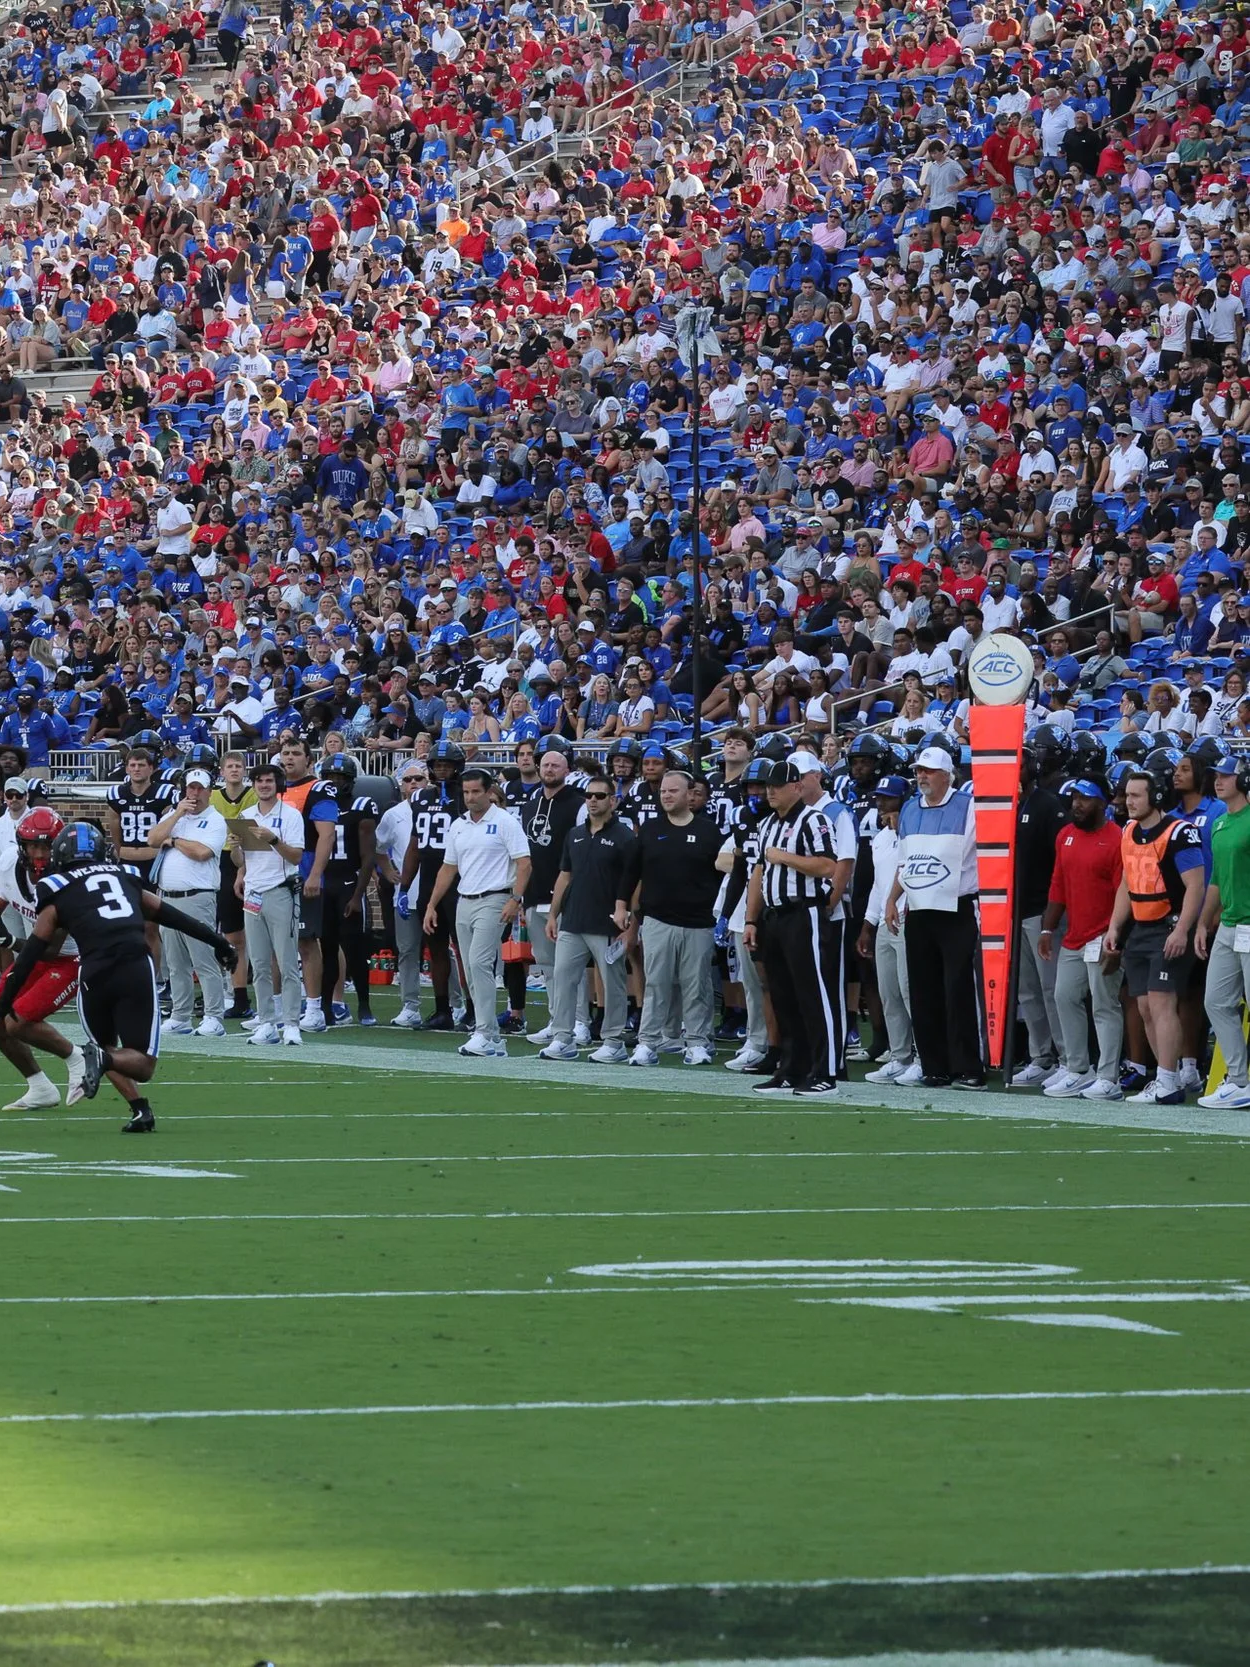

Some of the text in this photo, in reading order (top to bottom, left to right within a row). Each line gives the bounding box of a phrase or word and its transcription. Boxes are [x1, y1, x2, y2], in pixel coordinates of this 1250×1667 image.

[49, 239, 57, 249] D
[94, 264, 109, 272] DUKE
[430, 259, 442, 273] 19
[244, 363, 258, 371] DUKE
[332, 469, 357, 486] DUKE
[1053, 495, 1074, 507] DUKE
[171, 582, 190, 593] DUKE
[596, 655, 608, 664] 28
[71, 665, 94, 674] DUKE
[979, 660, 1017, 674] ACC
[20, 733, 29, 748] 1
[1217, 757, 1227, 766] D
[878, 777, 889, 788] D
[325, 785, 338, 797] 52
[711, 790, 726, 798] DUKE
[853, 801, 868, 809] DUKE
[272, 817, 282, 828] D
[1021, 813, 1030, 823] D
[1195, 815, 1207, 827] D
[120, 811, 157, 842] 88
[197, 820, 208, 828] D
[486, 824, 497, 834] D
[415, 812, 451, 849] 93
[749, 831, 758, 839] DU
[1184, 828, 1202, 843] 38
[600, 838, 614, 847] Duke
[686, 834, 696, 843] D
[1064, 836, 1073, 846] D
[68, 864, 121, 879] WEAVER
[907, 863, 942, 875] ACC
[84, 873, 134, 919] 3
[1159, 971, 1168, 981] D
